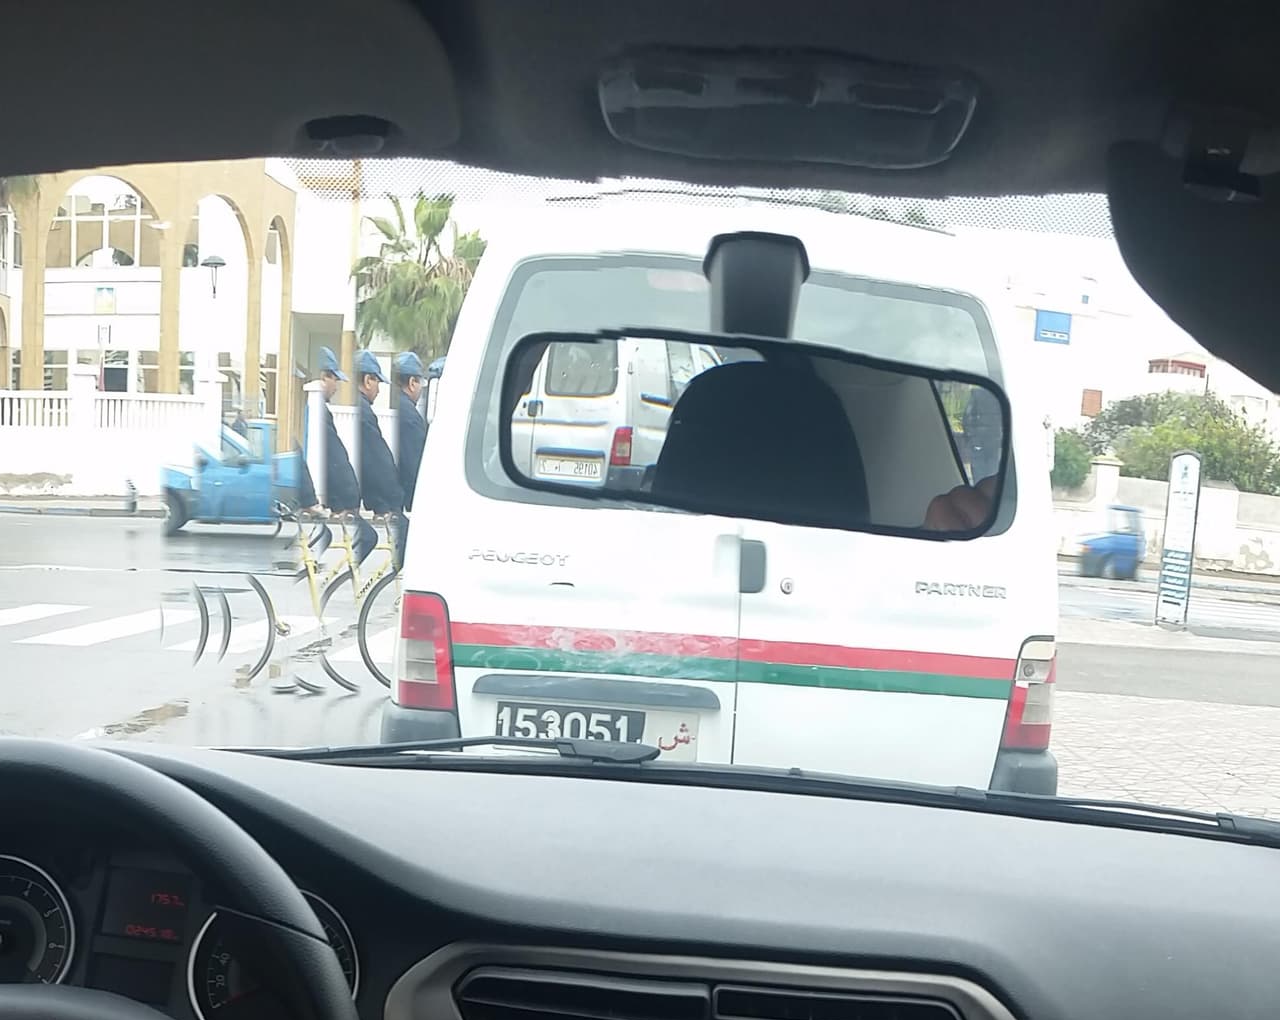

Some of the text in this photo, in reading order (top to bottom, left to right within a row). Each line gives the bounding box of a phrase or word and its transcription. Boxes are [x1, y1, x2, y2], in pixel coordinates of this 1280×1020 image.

[467, 548, 570, 567] PEUGEOT
[914, 580, 1008, 600] PARTNER
[497, 705, 630, 745] 153051
